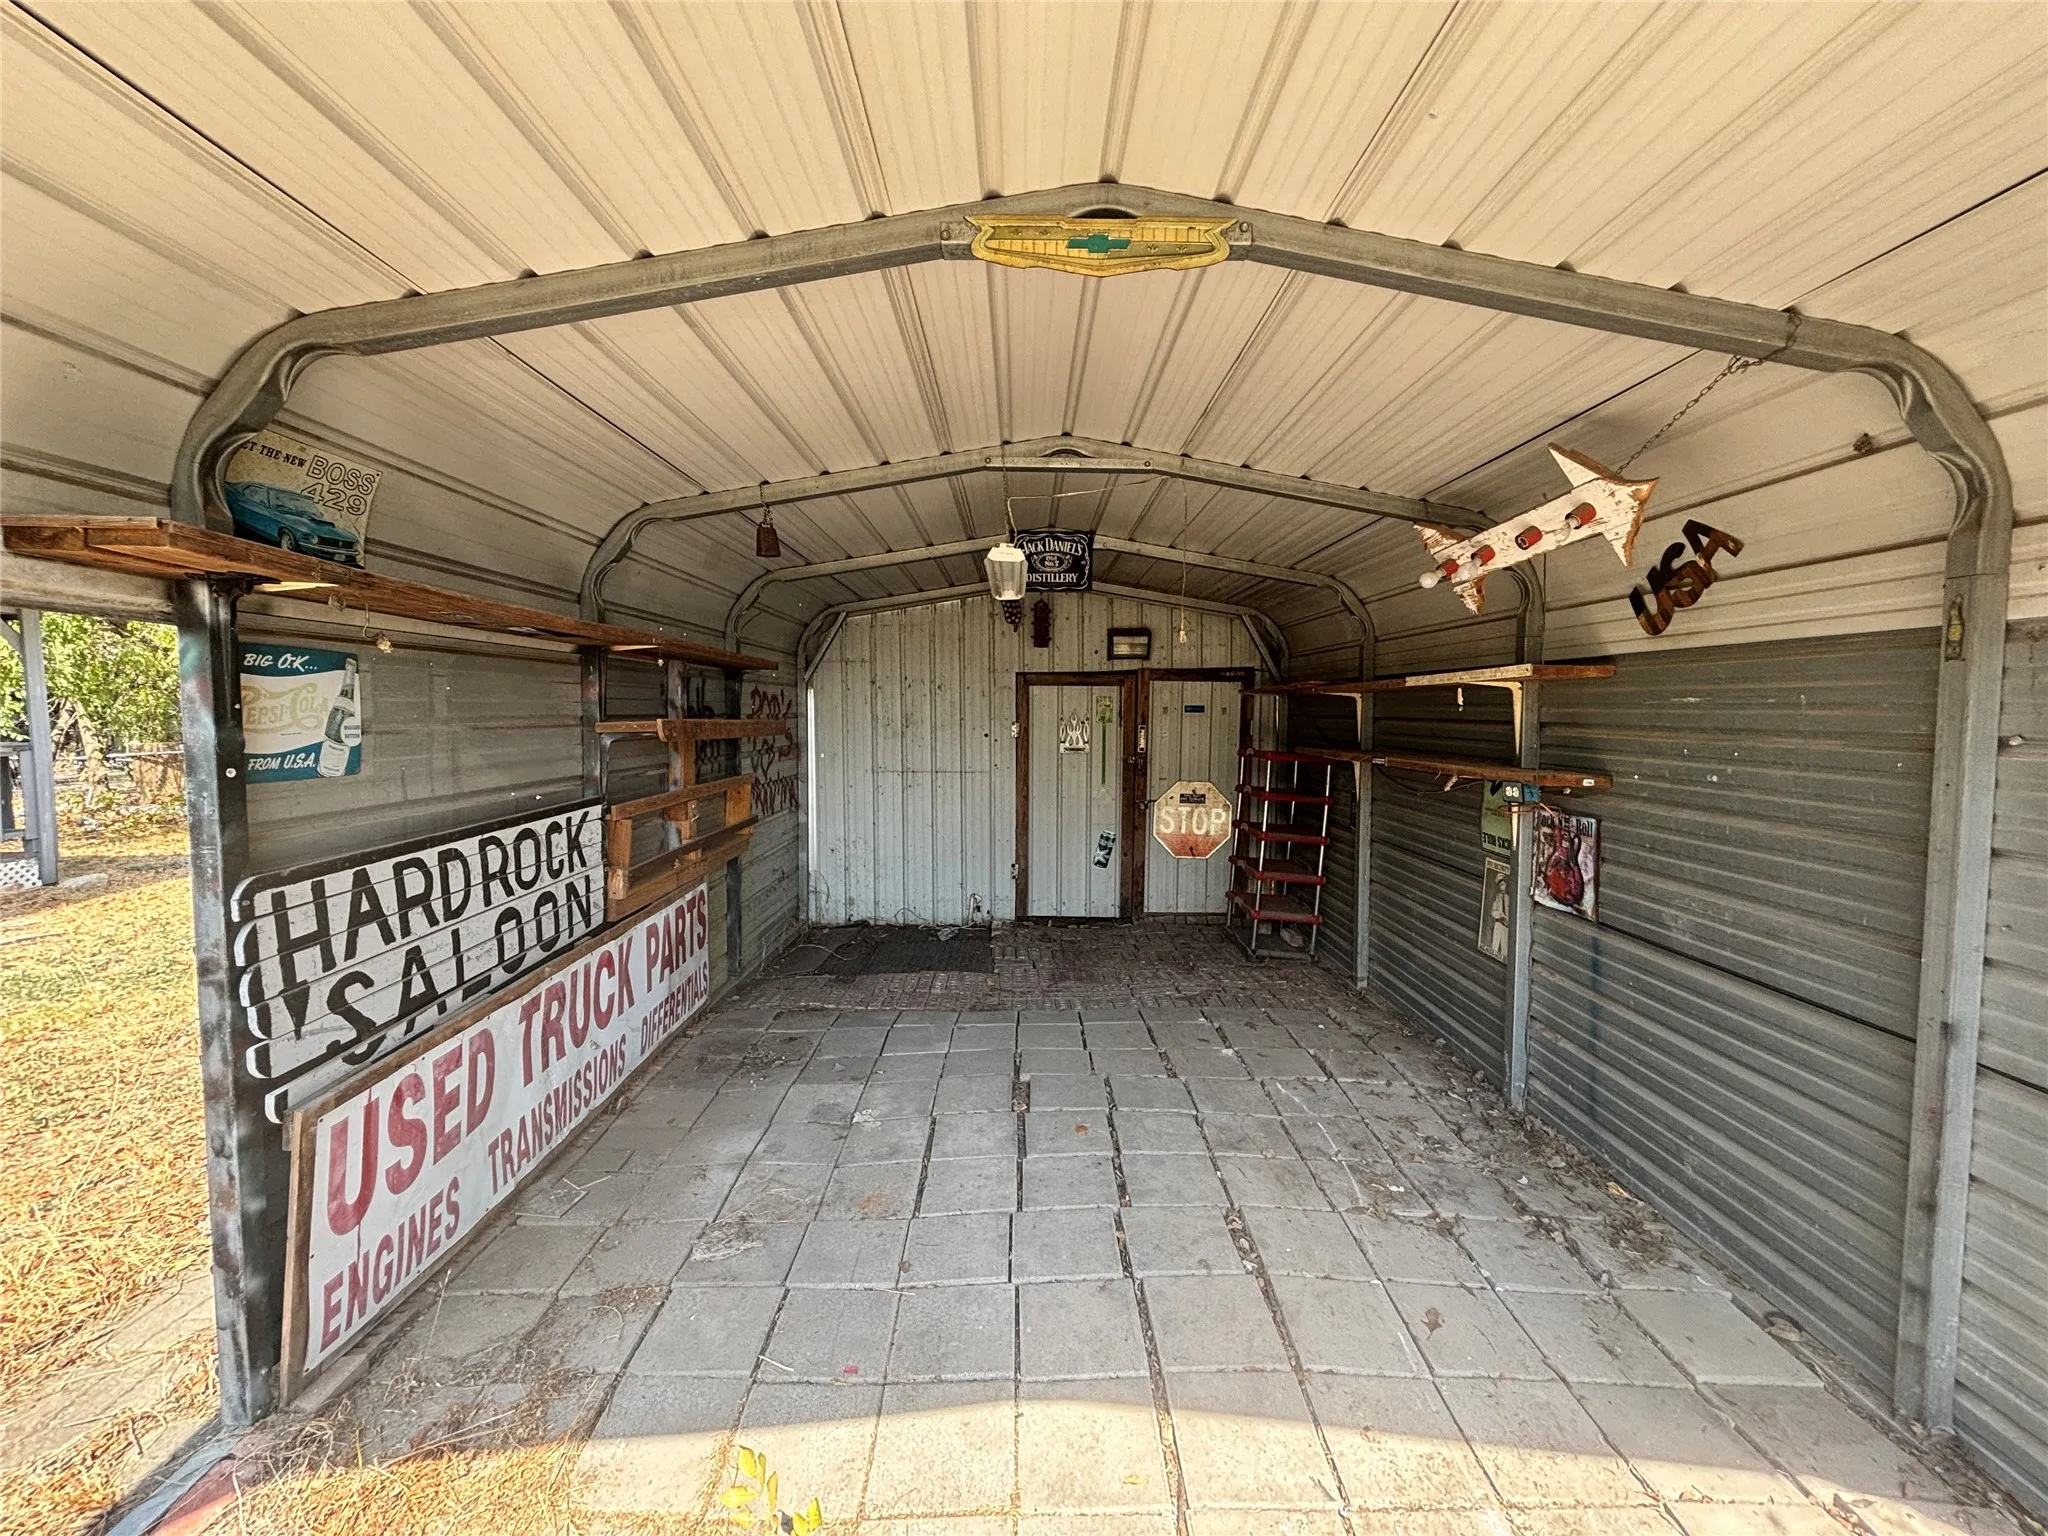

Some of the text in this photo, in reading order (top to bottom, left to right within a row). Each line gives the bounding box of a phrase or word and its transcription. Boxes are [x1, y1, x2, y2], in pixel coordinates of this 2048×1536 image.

[240, 439, 308, 468] ET THE NEW
[307, 454, 376, 496] BOSS
[301, 482, 368, 516] 429
[1022, 540, 1045, 555] JACK
[1026, 573, 1079, 583] DISTILLERY
[243, 653, 274, 667] BIG
[247, 752, 316, 771] FROM U.S.A.
[1159, 806, 1227, 835] STOP
[1577, 818, 1594, 838] Roll
[1497, 836, 1511, 851] CKS
[325, 874, 592, 1066] SALOON
[326, 888, 708, 1237] USED TRUCK PARTS
[320, 962, 709, 1353] ENGINES TRANSMISSIONS DIFFERENTIALS
